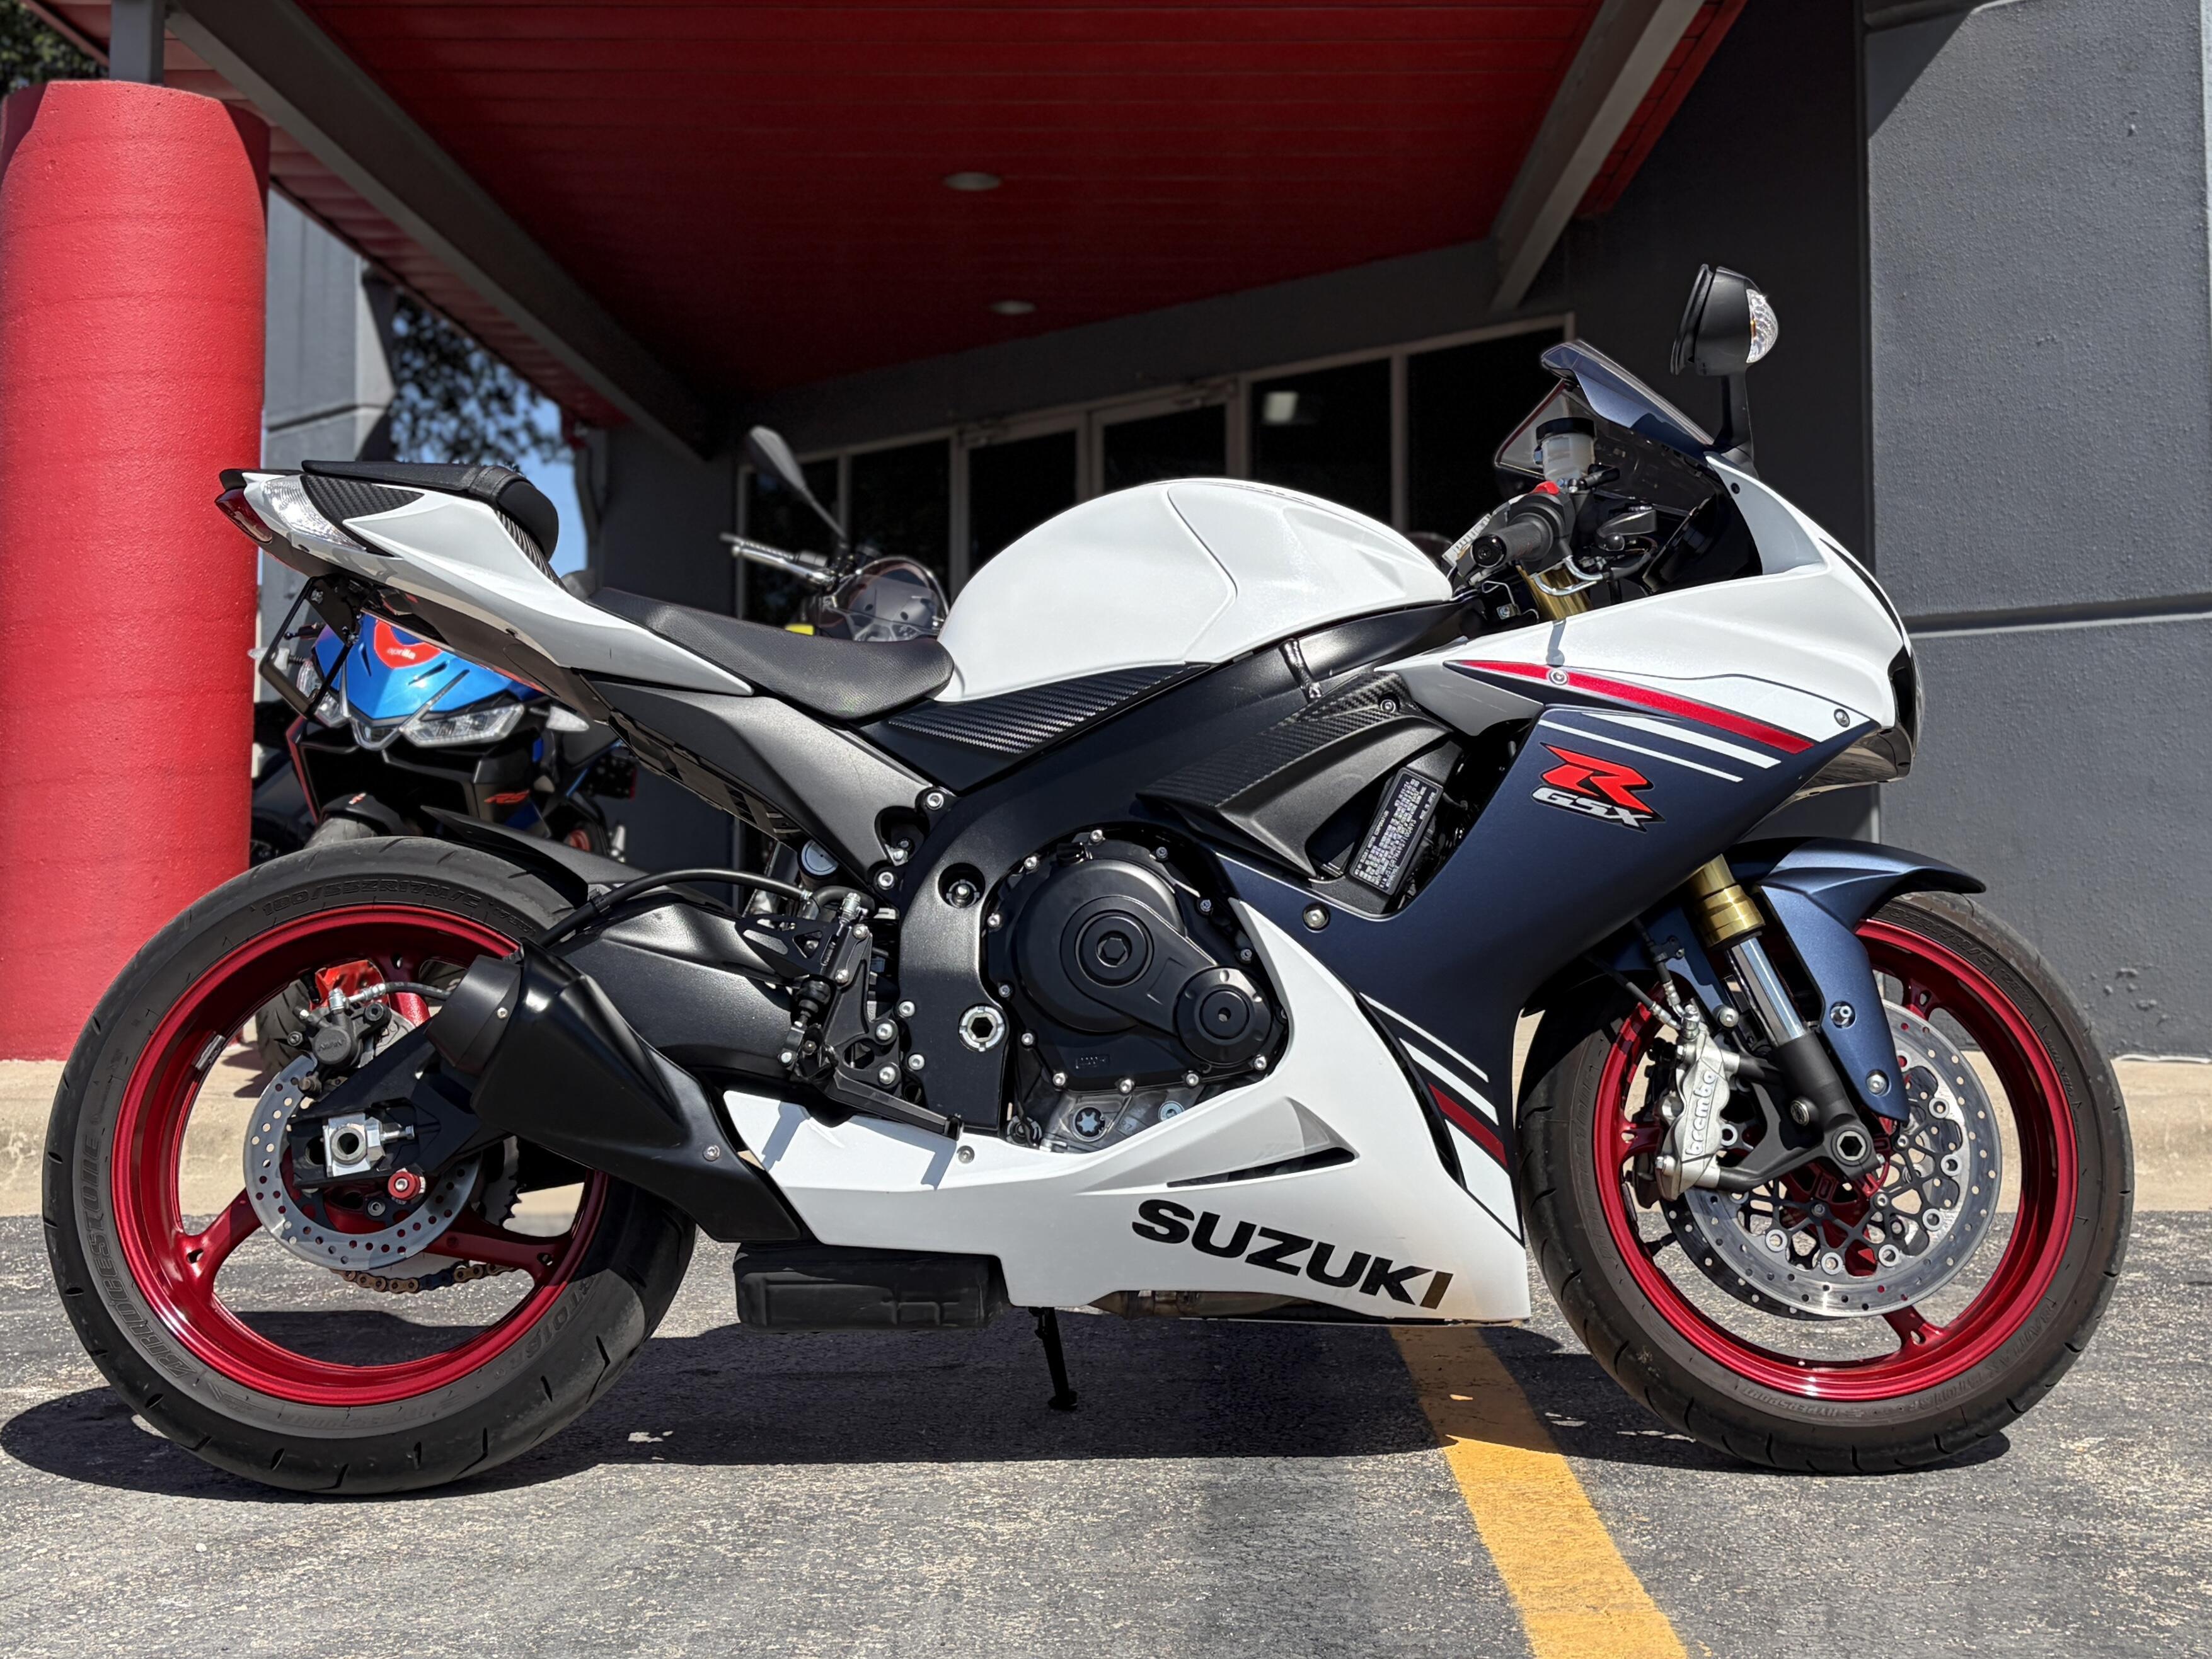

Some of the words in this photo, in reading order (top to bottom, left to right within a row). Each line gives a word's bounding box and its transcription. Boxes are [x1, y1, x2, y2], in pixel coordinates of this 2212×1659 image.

[1532, 786, 1653, 827] GSX
[1544, 744, 1654, 813] R
[1685, 1070, 1717, 1156] brembo
[77, 1133, 198, 1379] BRIDGESTONE
[1132, 1199, 1454, 1309] SUZUKI
